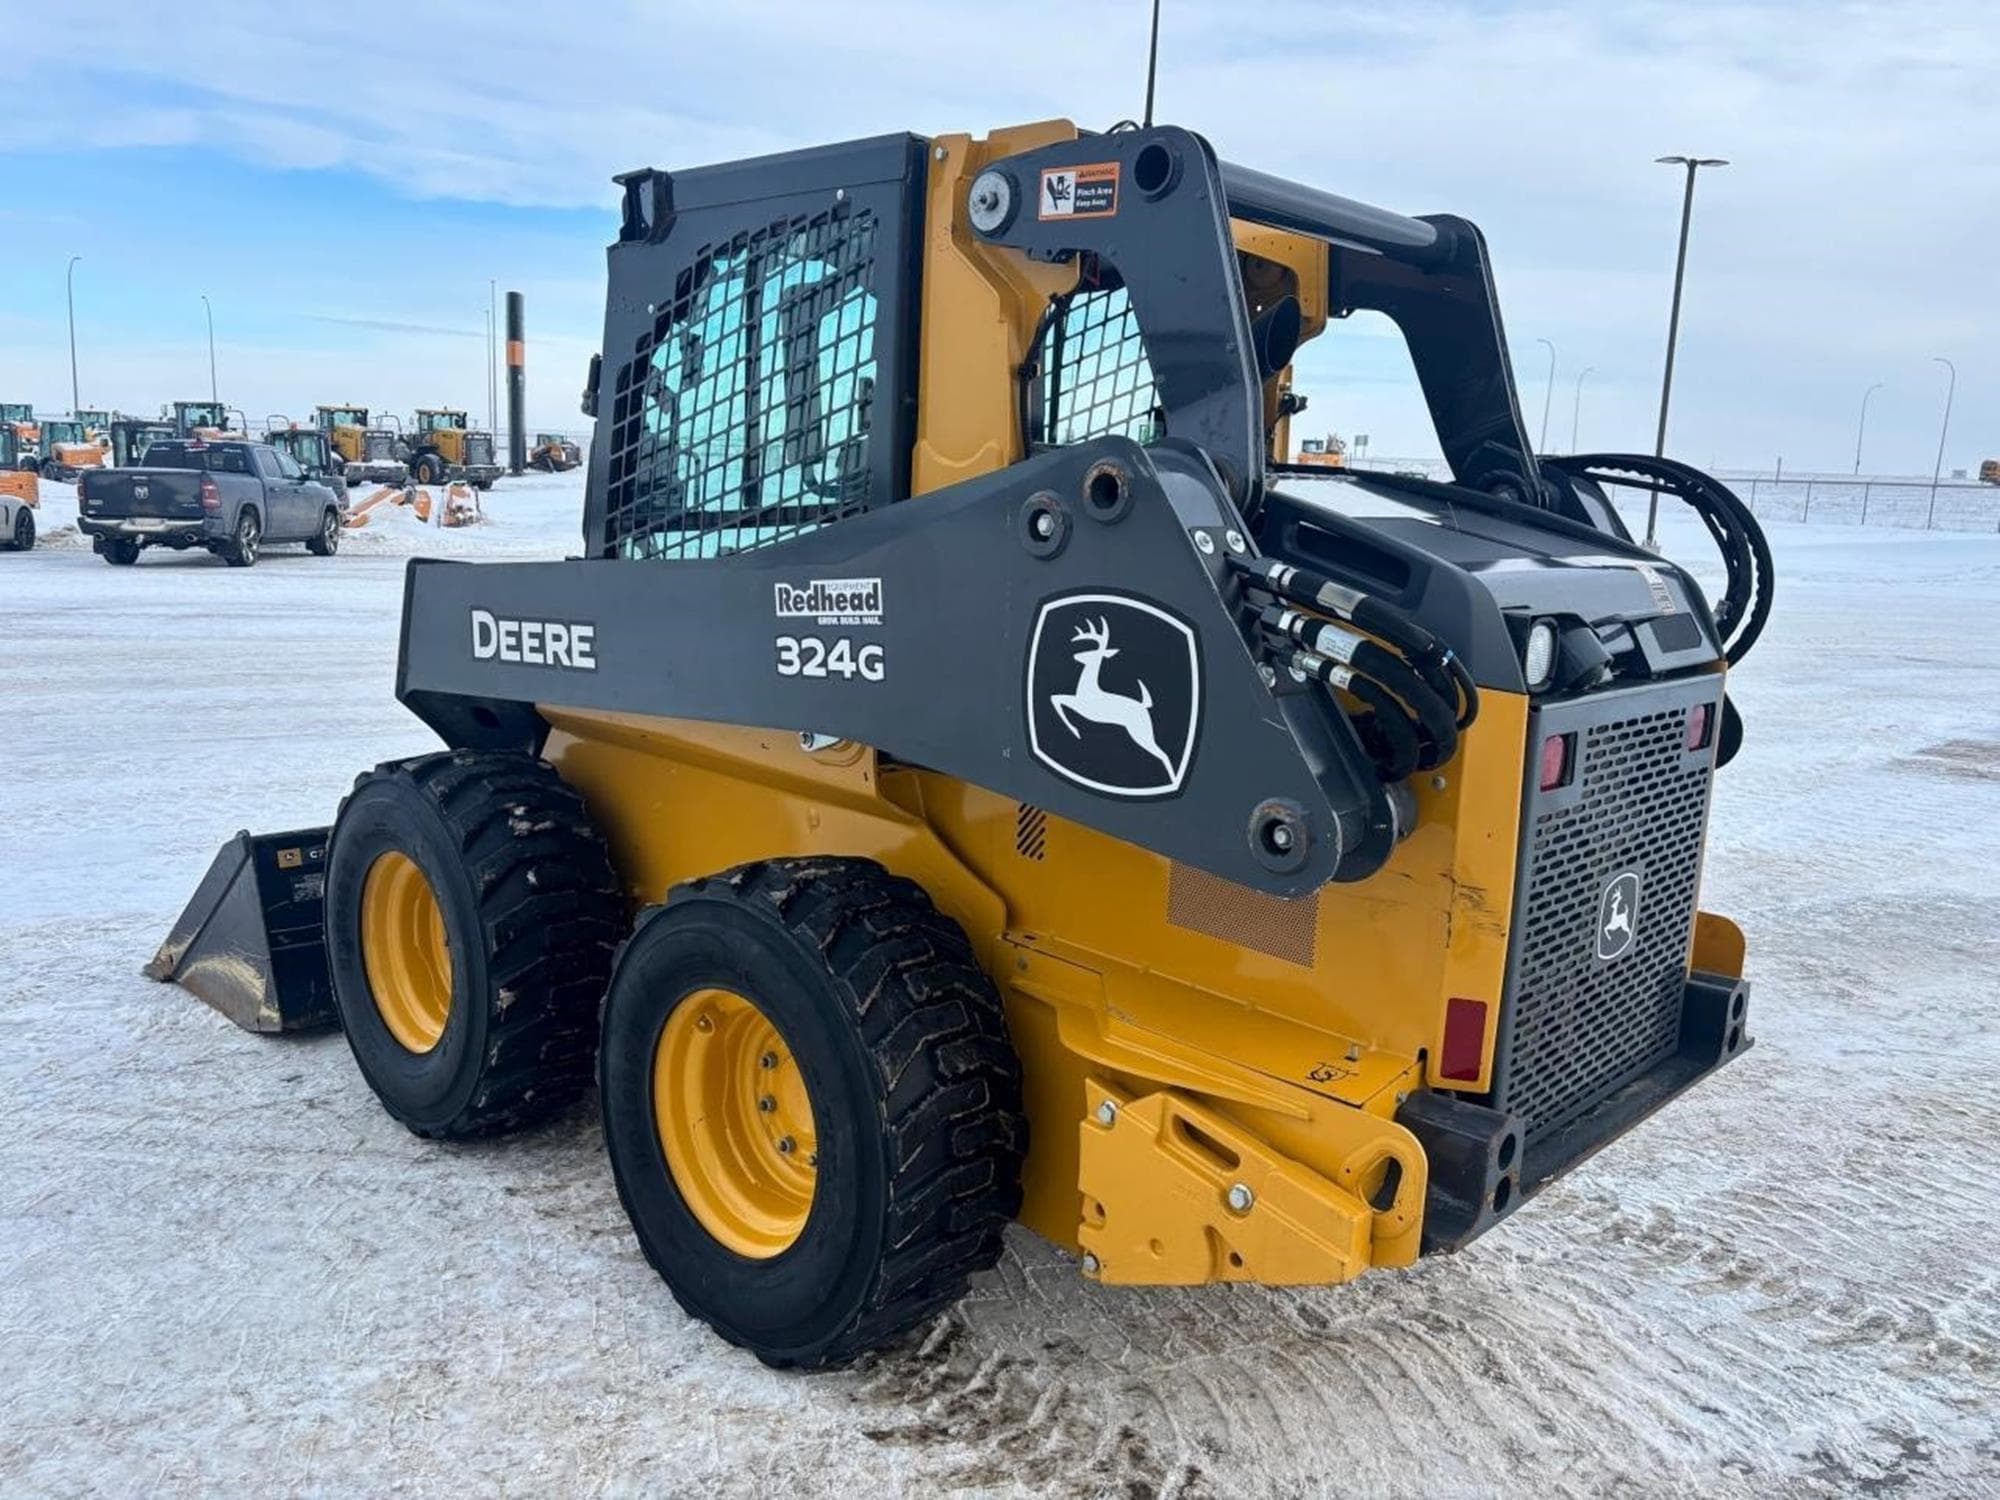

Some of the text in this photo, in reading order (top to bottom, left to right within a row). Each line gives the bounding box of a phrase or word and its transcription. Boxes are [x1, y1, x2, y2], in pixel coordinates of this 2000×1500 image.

[1077, 188, 1095, 197] Pinch
[777, 582, 879, 612] Redhead
[471, 609, 596, 669] DEERE
[776, 636, 885, 681] 324G
